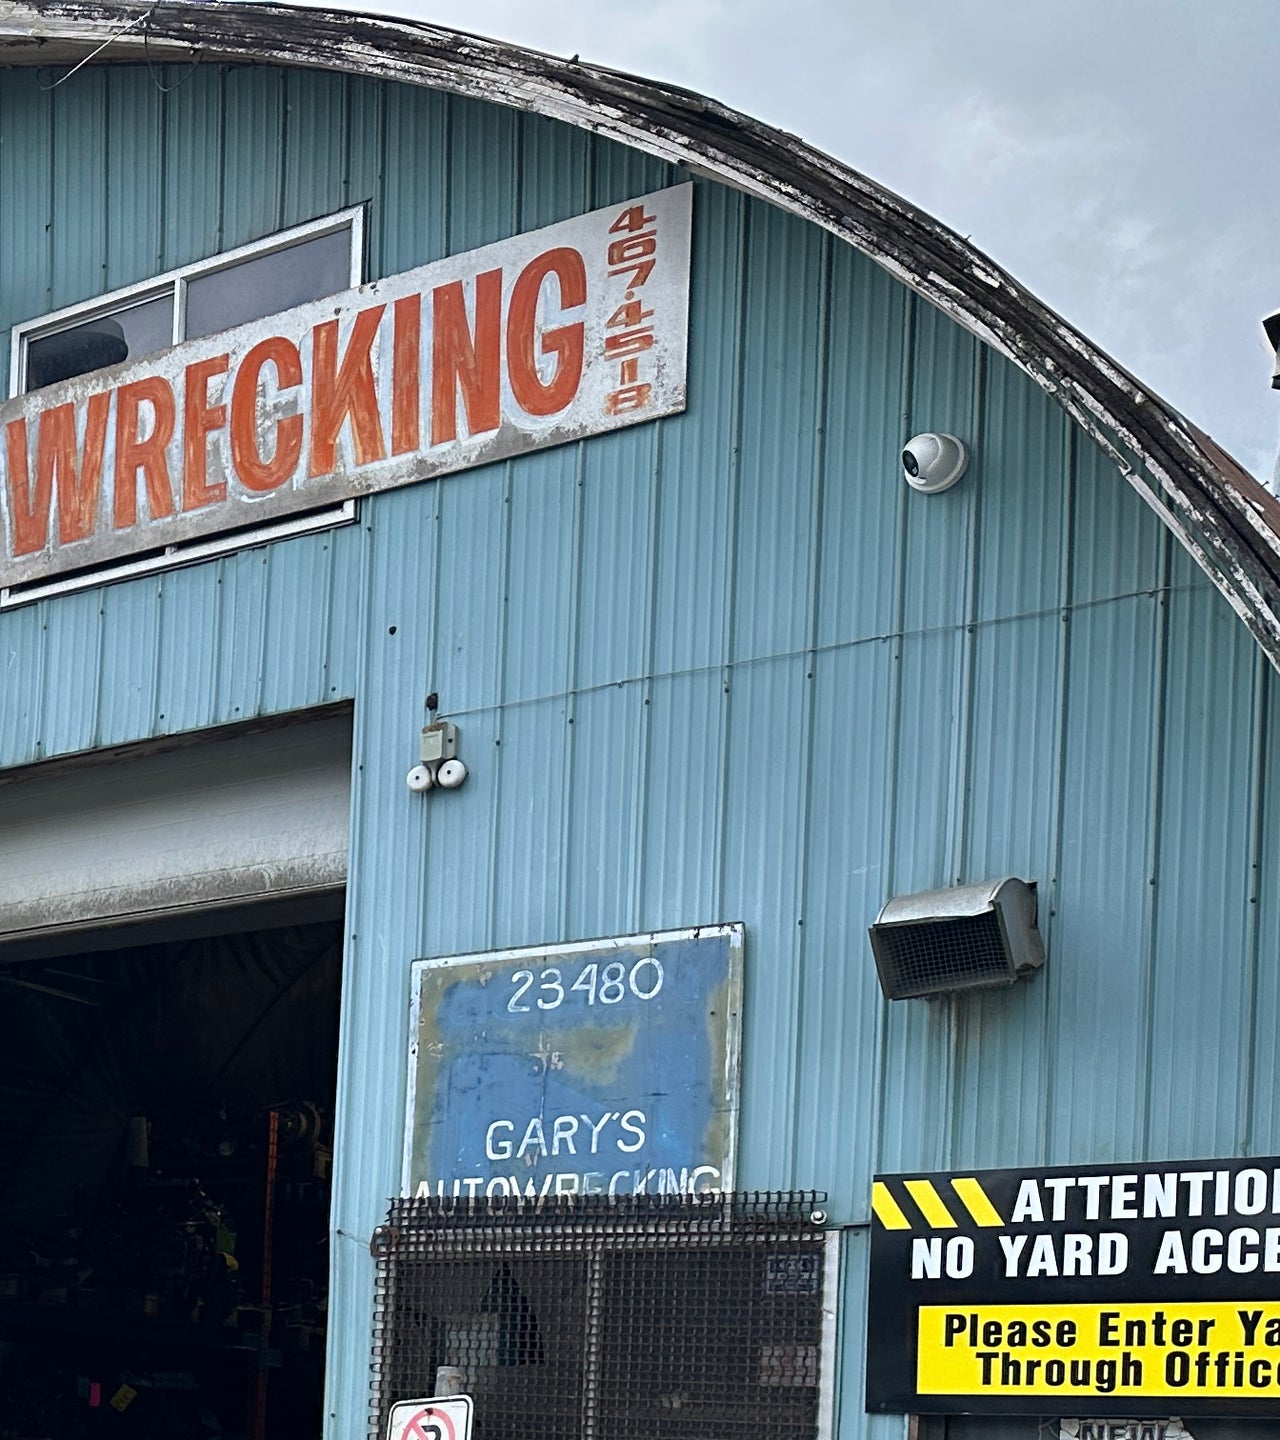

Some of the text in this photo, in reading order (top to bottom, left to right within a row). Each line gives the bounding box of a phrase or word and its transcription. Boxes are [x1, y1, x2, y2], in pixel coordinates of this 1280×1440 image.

[2, 246, 589, 558] WRECKING
[507, 957, 664, 1013] 23480
[486, 1109, 646, 1160] GARY'S
[1011, 1168, 1280, 1224] ATTENTIO
[911, 1235, 975, 1280] NO
[999, 1231, 1129, 1278] YARD
[944, 1313, 1077, 1347] Please
[1099, 1311, 1216, 1347] Enter
[976, 1350, 1280, 1393] Through Offic
